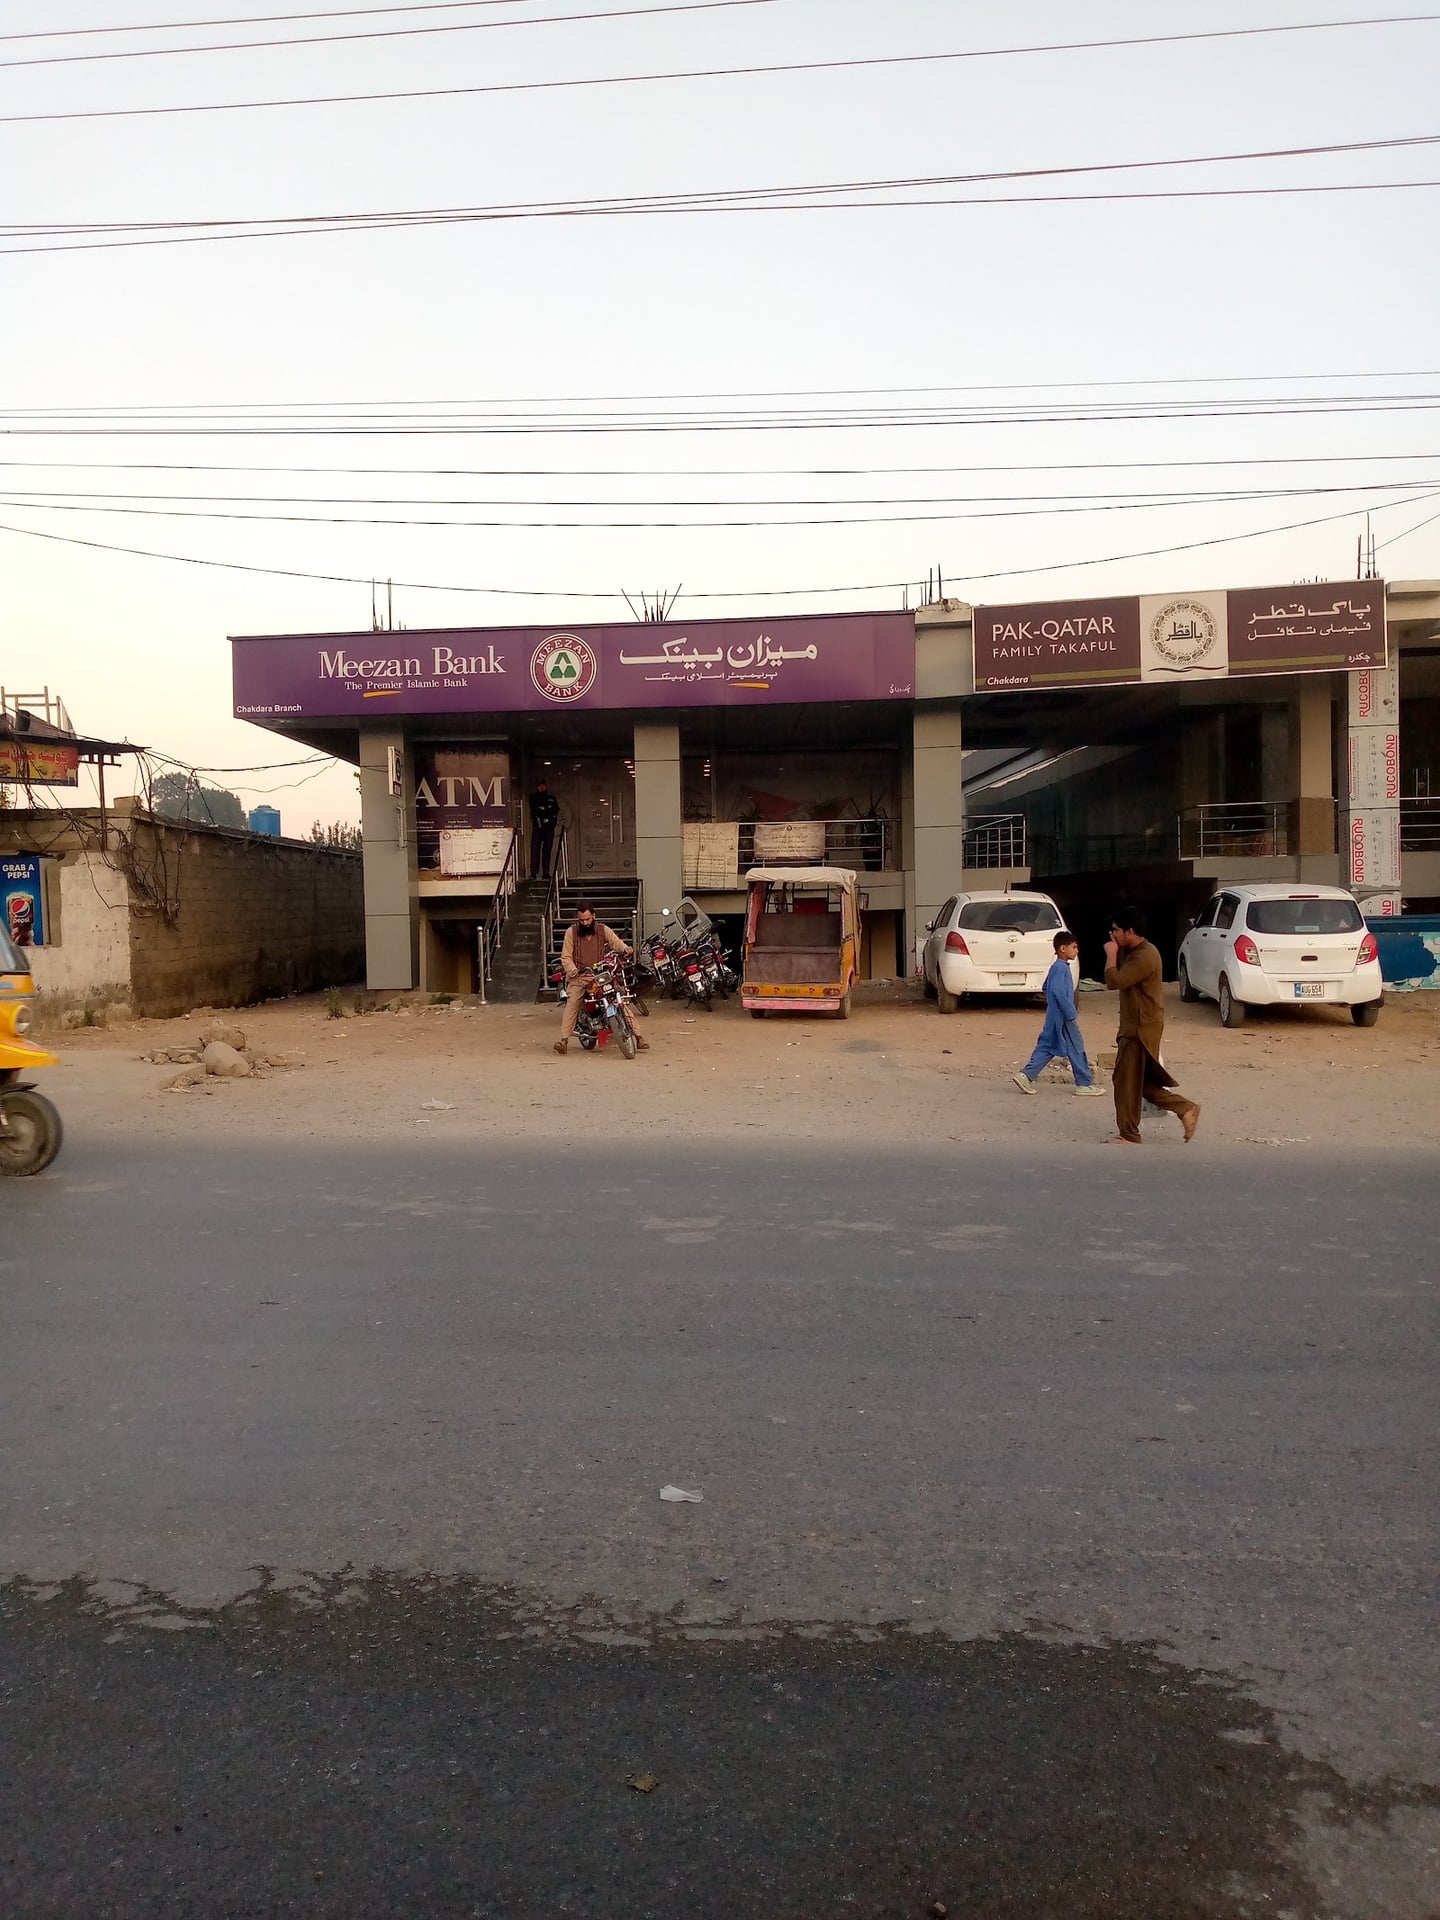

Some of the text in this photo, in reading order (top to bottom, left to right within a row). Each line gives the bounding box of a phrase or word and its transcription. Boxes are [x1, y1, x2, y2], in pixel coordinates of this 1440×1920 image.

[1248, 599, 1371, 625] پاک قطر
[992, 616, 1115, 641] PAK-QATAR
[1247, 620, 1371, 641] فیملی تکافل
[536, 639, 590, 666] MEEZAN
[619, 634, 818, 670] میزان بینک
[992, 640, 1117, 659] FAMILY TAKAFUL
[318, 646, 506, 679] Meezan Bank
[344, 678, 468, 691] The Premier Islamic Bank
[644, 672, 685, 681] بینک
[686, 671, 725, 682] اسلامی
[986, 674, 1029, 686] Chakdara
[544, 680, 583, 697] BANK
[1359, 669, 1370, 717] RUCOBO
[236, 703, 302, 713] Chakdara Branch
[1386, 734, 1397, 799] RUCOBOND
[415, 776, 506, 808] ATM
[1354, 818, 1364, 882] RUCOBOND
[2, 863, 35, 872] GRAB A
[7, 871, 30, 879] PEPSI
